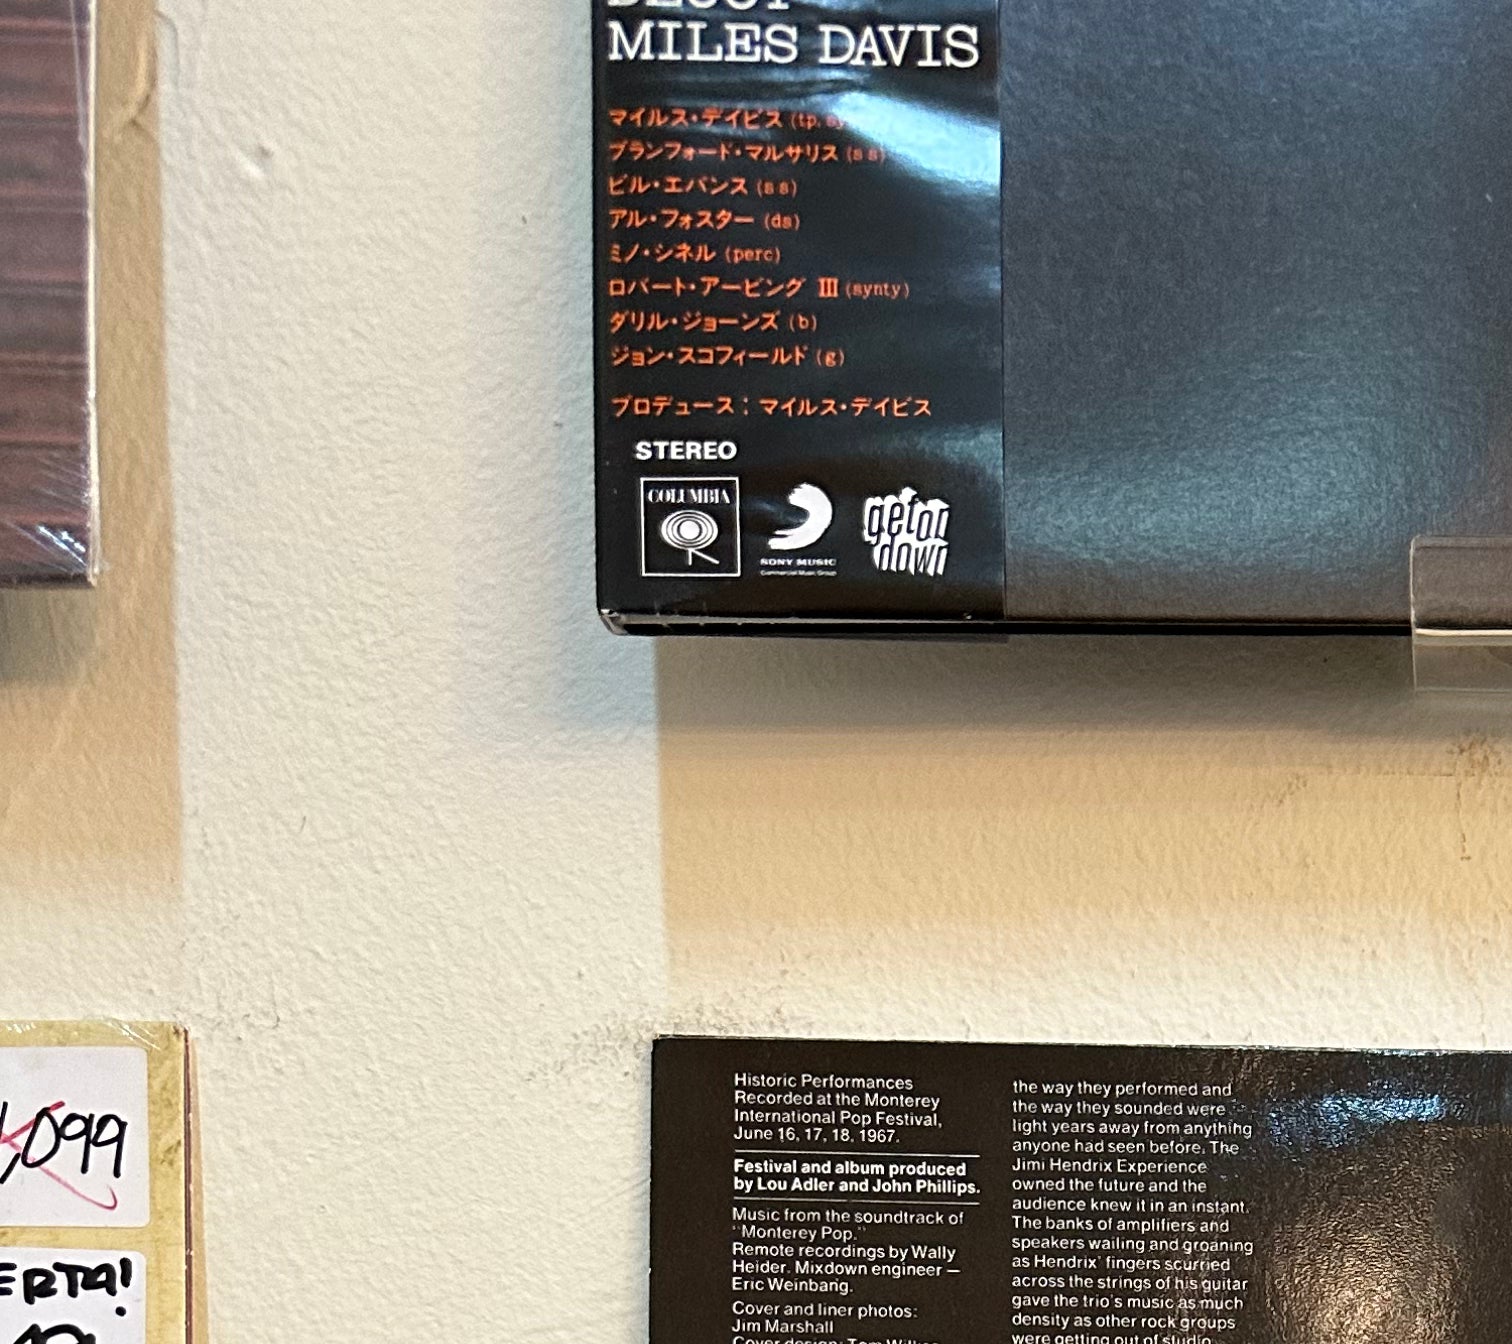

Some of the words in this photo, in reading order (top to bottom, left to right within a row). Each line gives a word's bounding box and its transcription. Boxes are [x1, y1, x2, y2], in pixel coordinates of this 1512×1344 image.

[608, 20, 798, 63] MILES
[818, 24, 980, 68] DAVIS
[608, 175, 748, 196] ビル・エバンス
[725, 245, 781, 265] (perc)
[789, 312, 818, 331] (b)
[815, 347, 846, 367] (g)
[635, 440, 738, 461] STEREO
[647, 487, 731, 504] COLUMBIA
[760, 557, 793, 567] SONY
[796, 557, 837, 567] MUSIC
[734, 1073, 797, 1088] Historic
[801, 1074, 913, 1090] Performances
[735, 1090, 813, 1105] Recorded
[816, 1093, 832, 1105] at
[835, 1092, 860, 1106] the
[865, 1092, 940, 1111] Monterey
[734, 1109, 835, 1124] International
[840, 1110, 871, 1128] Pop
[733, 1126, 773, 1140] June
[734, 1158, 797, 1173] Festival
[801, 1160, 831, 1174] and
[835, 1160, 885, 1175] album
[889, 1161, 966, 1178] produced
[1012, 1158, 1045, 1171] Jimi
[1050, 1158, 1112, 1172] Hendrix
[1117, 1159, 1207, 1176] Experience
[734, 1176, 753, 1193] by
[757, 1176, 787, 1191] Lou
[791, 1177, 835, 1192] Adler
[839, 1178, 869, 1192] and
[872, 1179, 912, 1193] John
[1012, 1312, 1070, 1330] density
[1073, 1316, 1092, 1327] as
[1095, 1314, 1137, 1327] other
[1141, 1314, 1178, 1328] rock
[1179, 1314, 1235, 1332] groups
